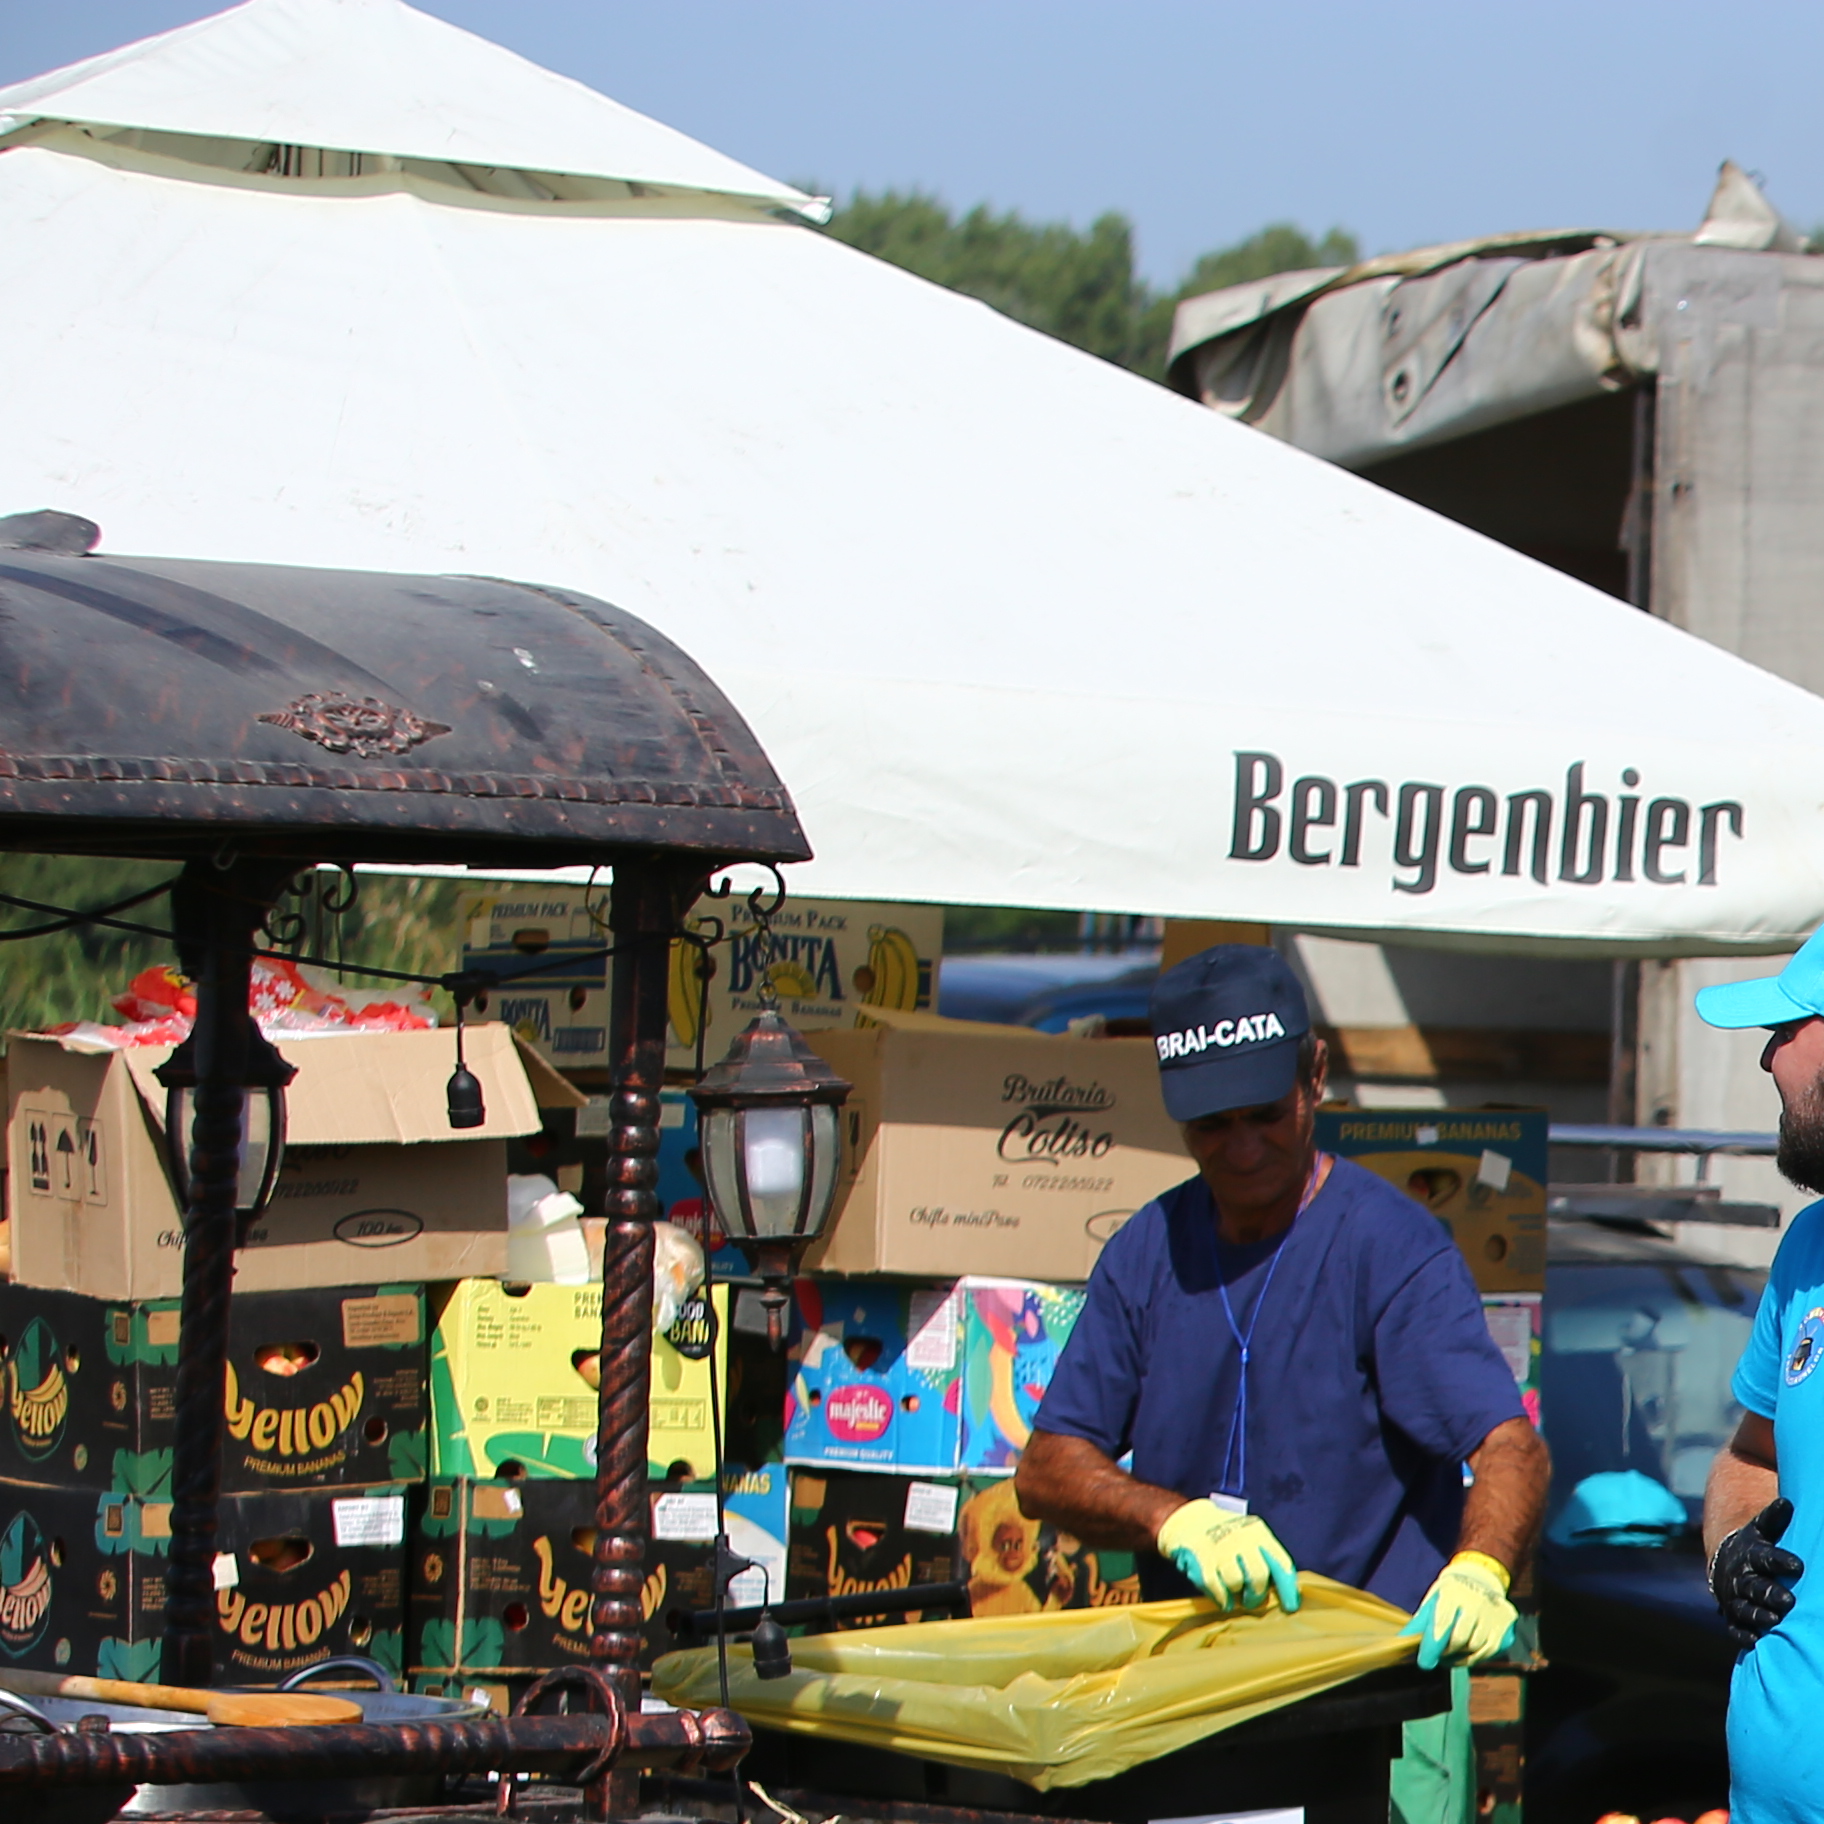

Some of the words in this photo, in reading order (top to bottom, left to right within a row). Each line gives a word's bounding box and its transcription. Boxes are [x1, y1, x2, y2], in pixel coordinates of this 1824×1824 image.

[1226, 749, 1744, 894] Bergenbier
[728, 929, 847, 1001] BONITA
[1156, 1012, 1286, 1061] BRAI-CATA
[1438, 1121, 1522, 1141] BANANAS
[243, 1455, 296, 1476] PREMIUM
[297, 1450, 346, 1474] BANANAS
[231, 1649, 281, 1671] PREMIUM
